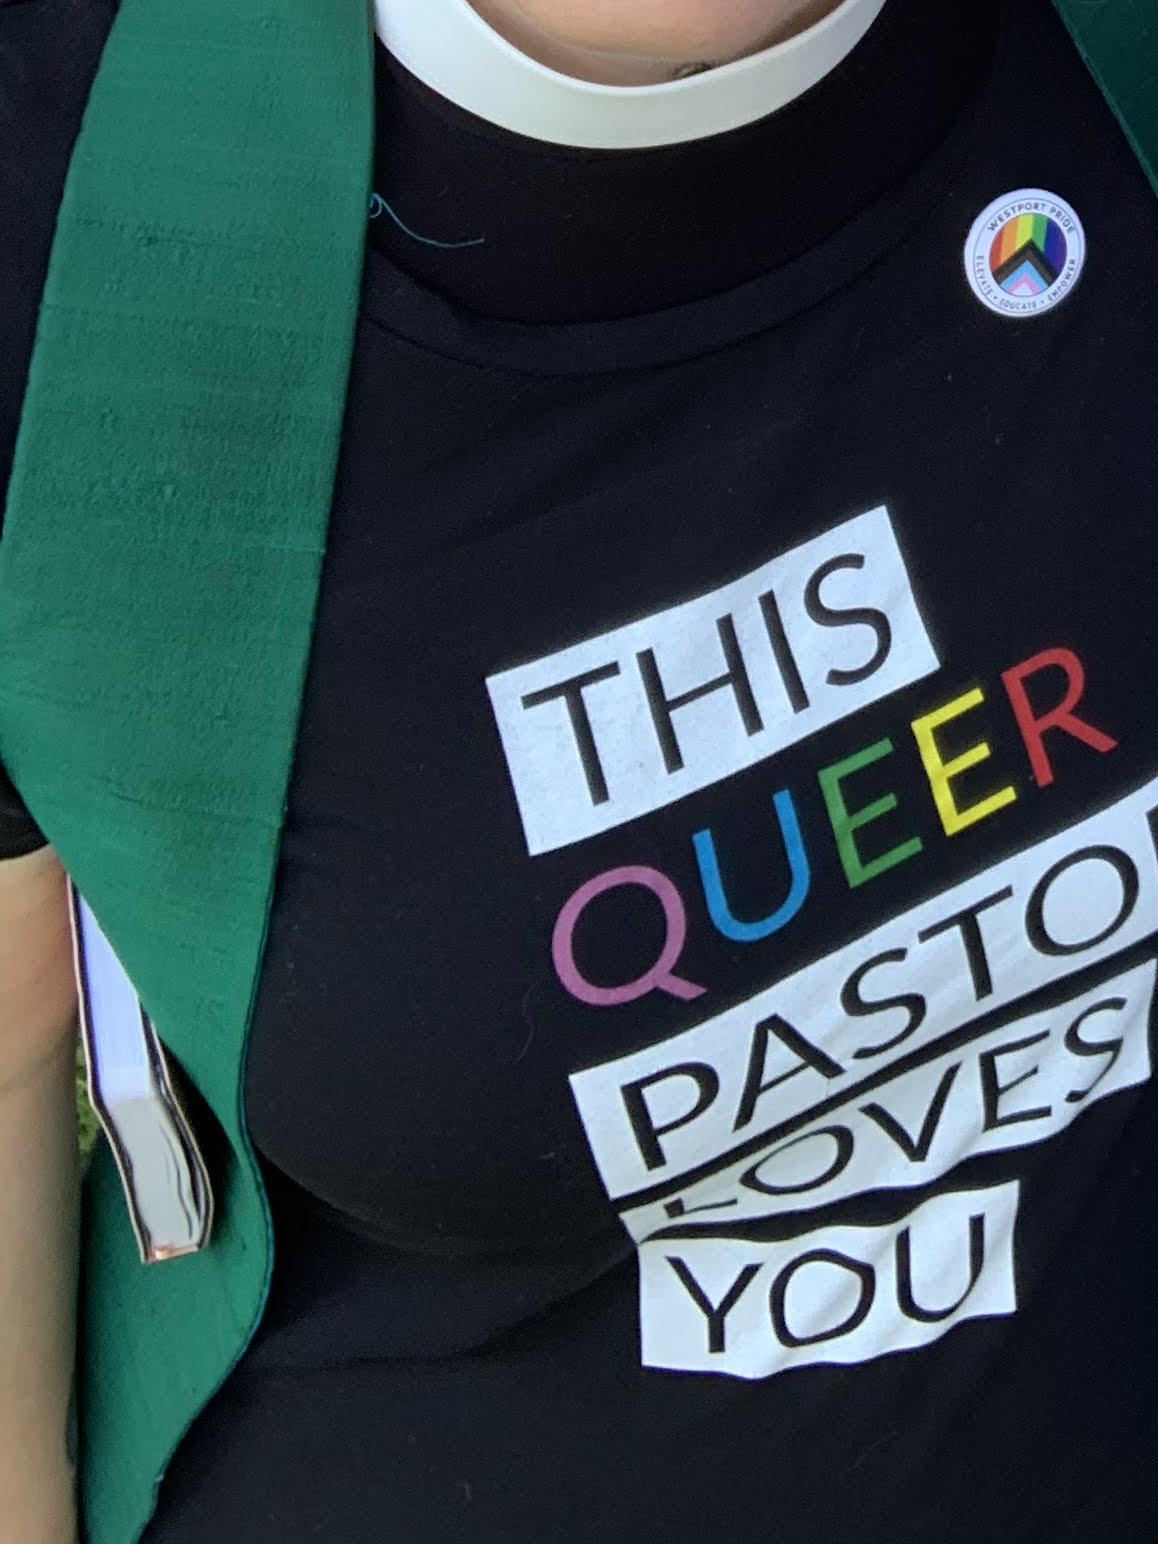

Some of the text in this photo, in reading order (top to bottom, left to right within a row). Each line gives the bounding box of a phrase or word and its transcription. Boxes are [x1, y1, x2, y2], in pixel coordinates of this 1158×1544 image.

[976, 256, 1076, 311] ELEVATE EDUCATE EMPOWER
[987, 202, 1076, 234] WESTPORT PRIDE
[521, 553, 891, 805] THIS
[551, 647, 1117, 1006] QUEER
[663, 996, 1127, 1219] LOVES
[667, 1214, 985, 1353] YOU
